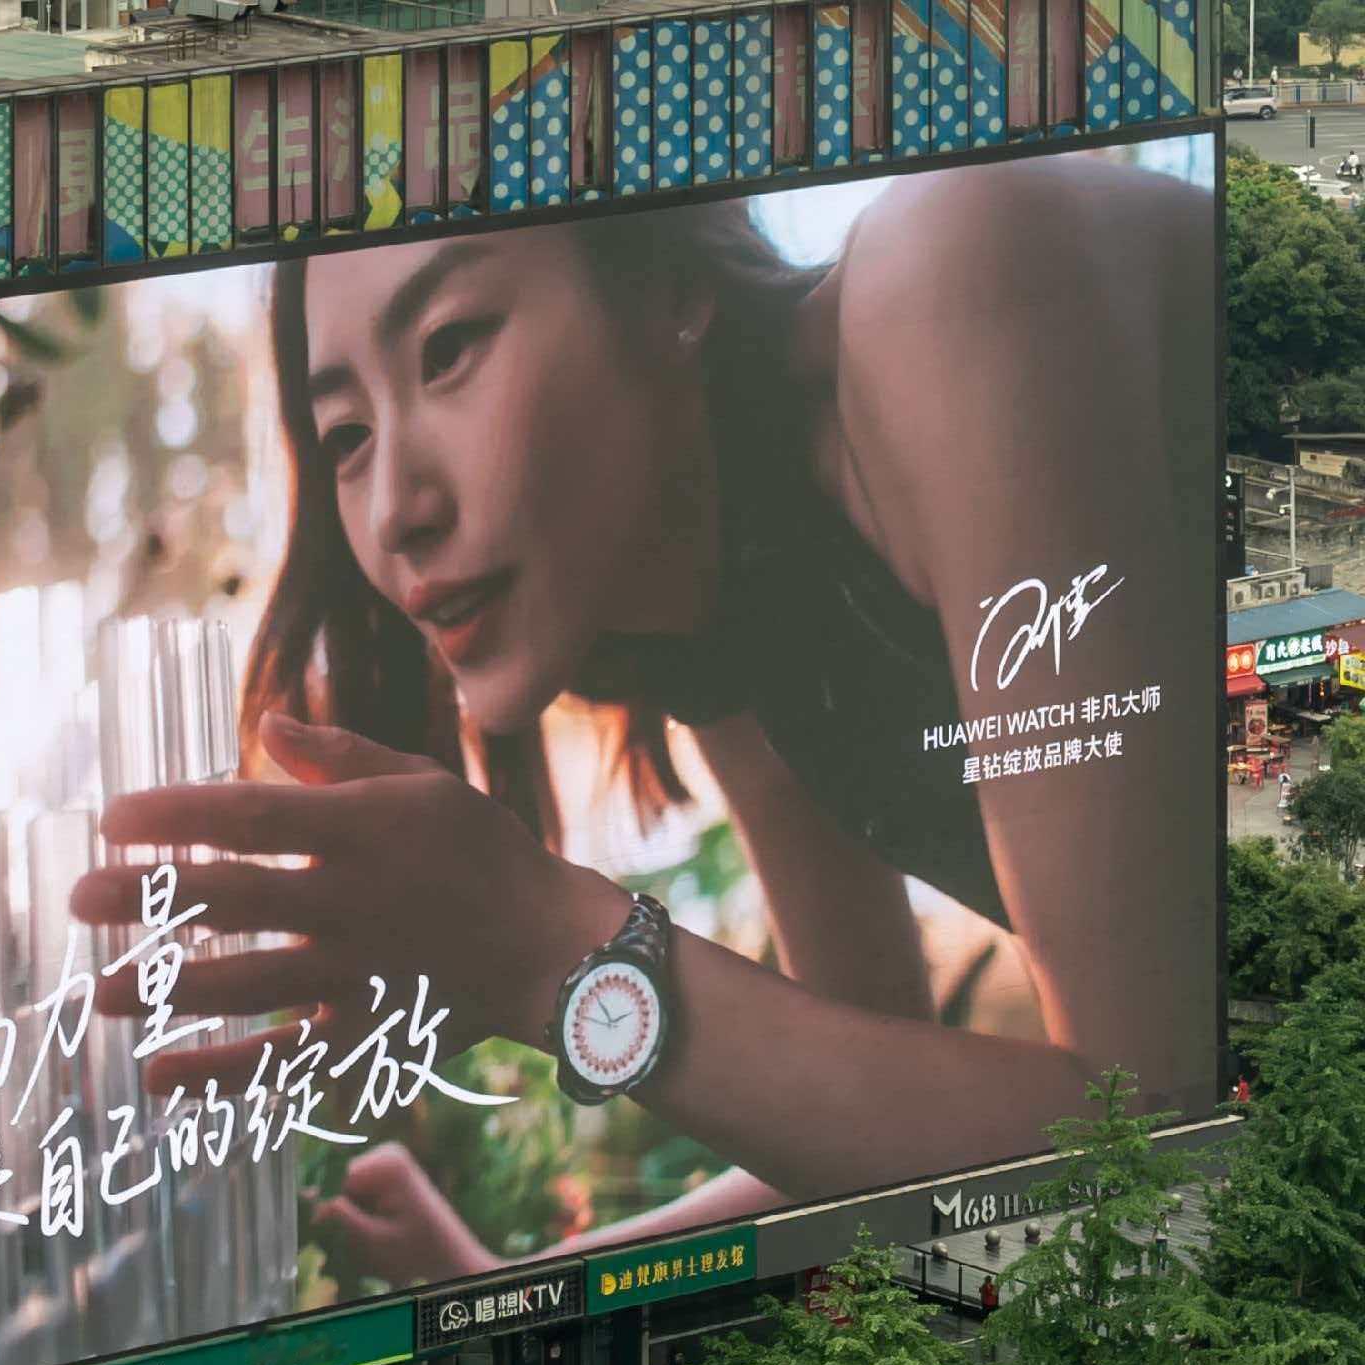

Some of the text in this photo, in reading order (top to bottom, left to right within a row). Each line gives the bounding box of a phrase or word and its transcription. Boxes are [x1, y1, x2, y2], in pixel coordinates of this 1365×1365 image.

[923, 685, 1161, 751] HUAWEI WATCH 非凡大师
[962, 731, 1123, 783] 星钻绽放品牌大使
